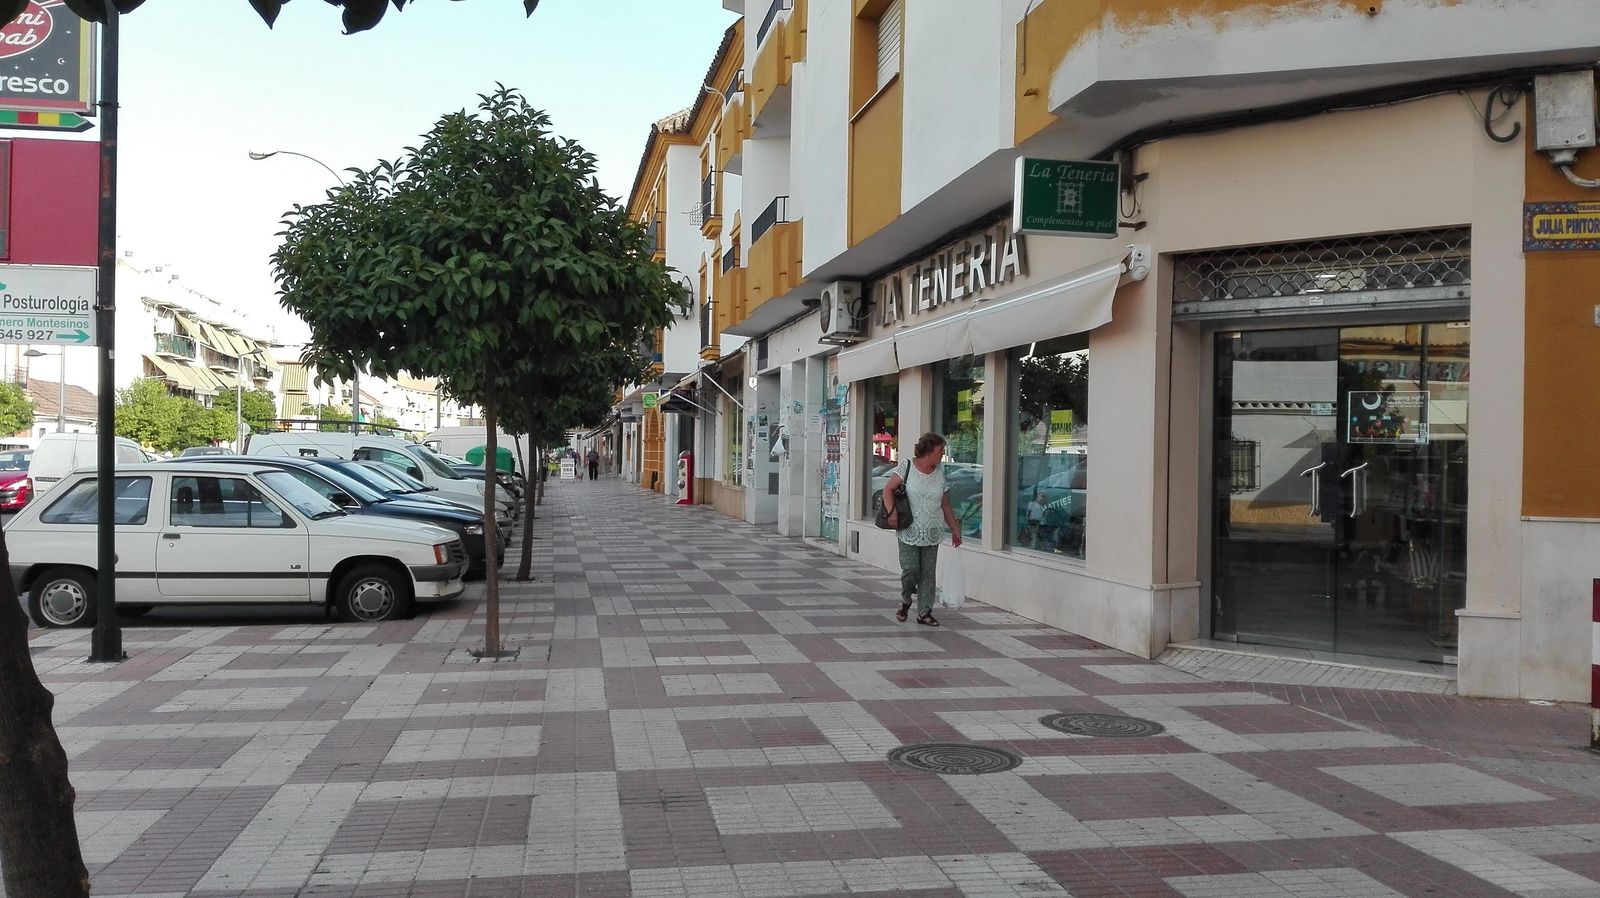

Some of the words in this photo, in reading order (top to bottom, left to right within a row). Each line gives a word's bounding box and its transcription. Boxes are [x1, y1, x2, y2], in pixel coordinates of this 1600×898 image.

[1028, 162, 1052, 178] La
[1026, 215, 1083, 228] Complementos
[1084, 219, 1095, 227] en
[1096, 219, 1113, 231] piel
[1536, 218, 1564, 235] JULIA
[907, 230, 1022, 315] TENERIA
[3, 294, 89, 314] Posturología
[26, 317, 89, 329] Montesinos
[27, 330, 54, 341] 927
